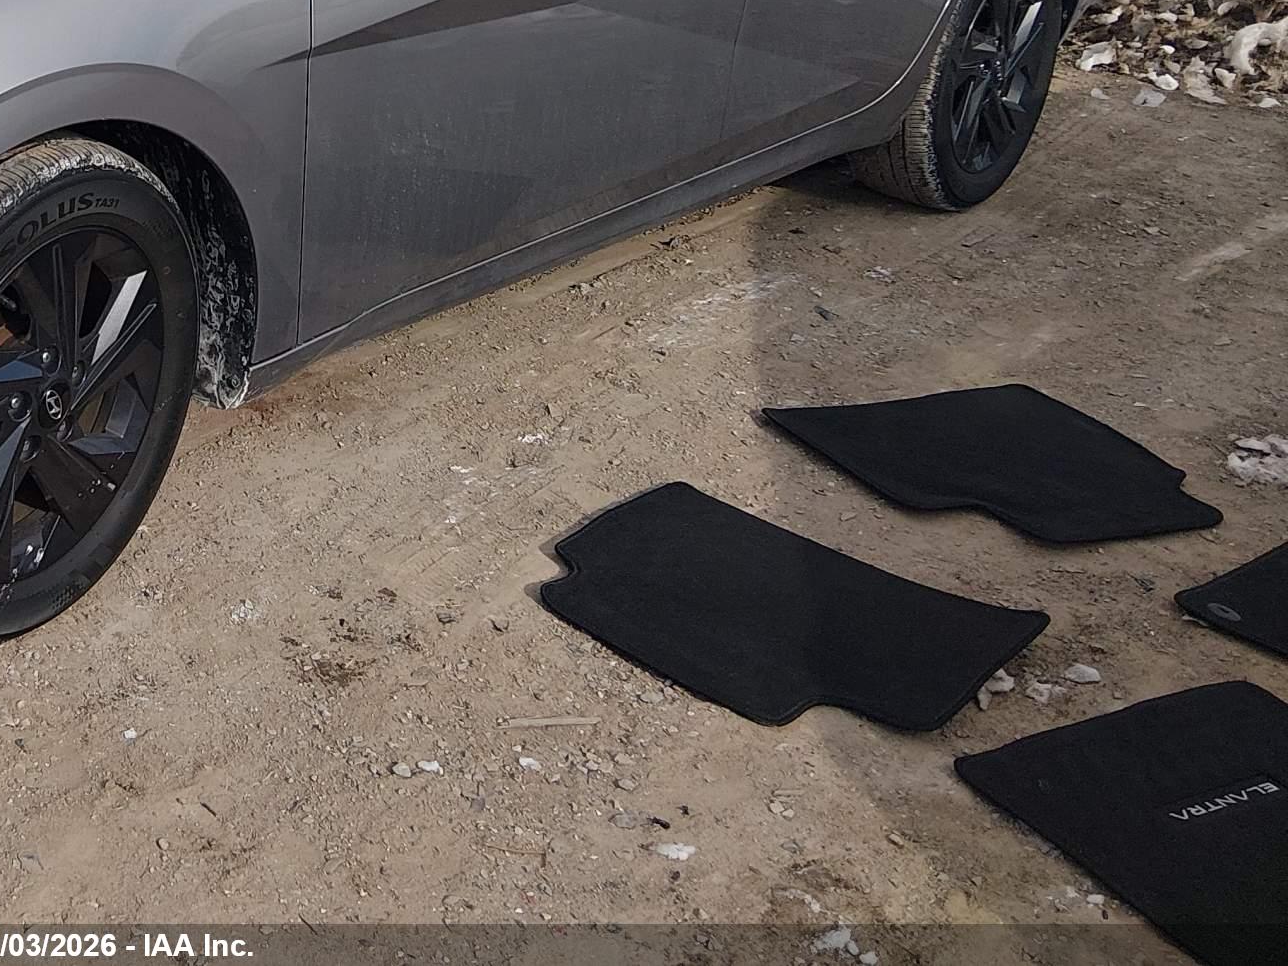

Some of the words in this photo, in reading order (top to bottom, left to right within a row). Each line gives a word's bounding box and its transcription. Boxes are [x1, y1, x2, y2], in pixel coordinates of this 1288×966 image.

[0, 192, 94, 257] SOLUS
[95, 197, 120, 209] TA31
[1169, 782, 1280, 820] ELANTRA
